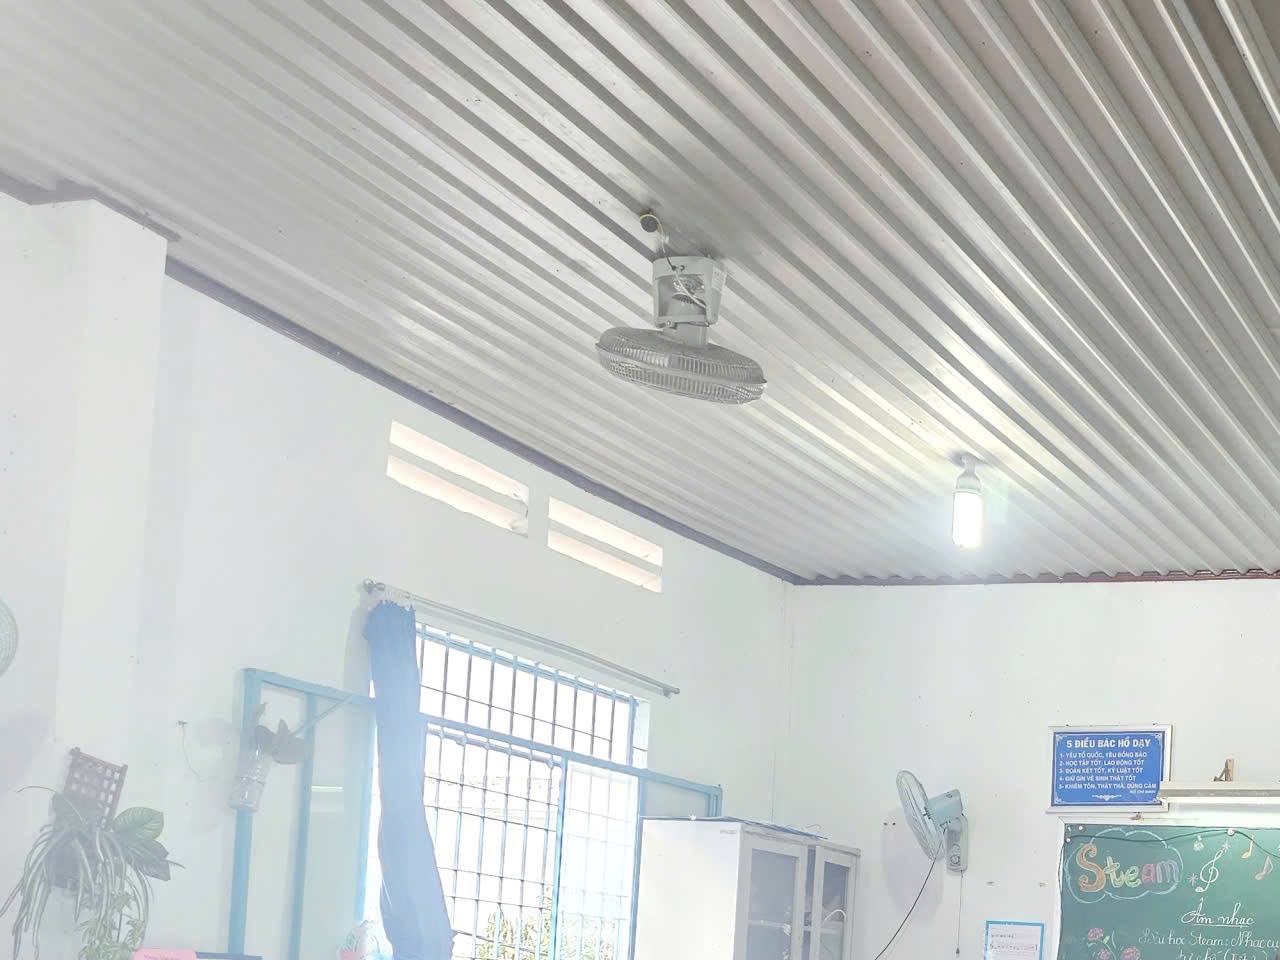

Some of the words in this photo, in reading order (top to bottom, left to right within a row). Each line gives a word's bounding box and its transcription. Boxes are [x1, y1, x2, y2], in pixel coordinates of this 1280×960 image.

[1066, 740, 1073, 748] 5
[1097, 737, 1116, 748] BÁC
[1132, 739, 1151, 749] DẠY
[1076, 843, 1180, 892] Steam
[1217, 902, 1256, 928] nhạc
